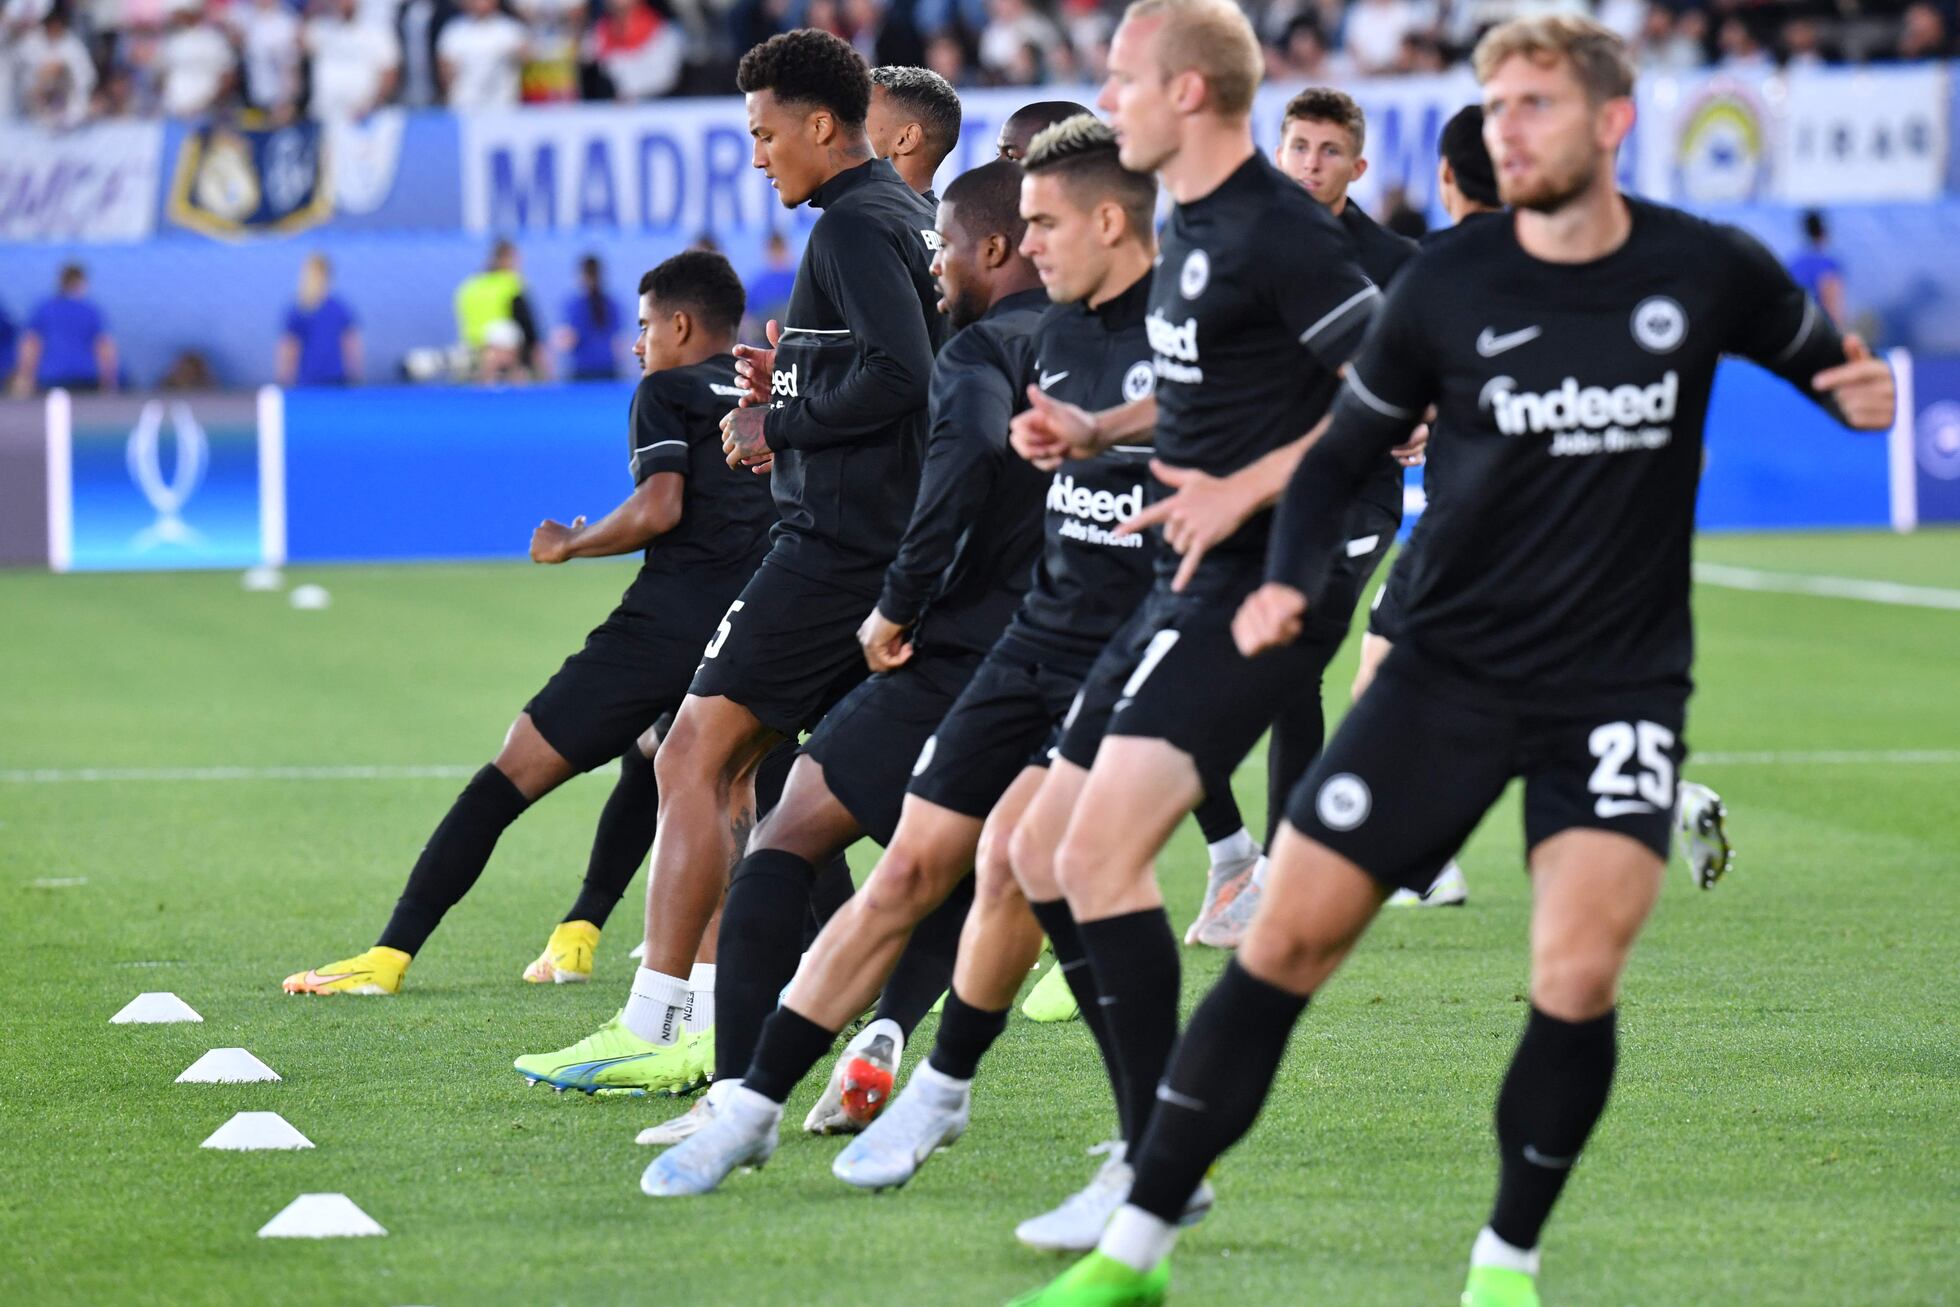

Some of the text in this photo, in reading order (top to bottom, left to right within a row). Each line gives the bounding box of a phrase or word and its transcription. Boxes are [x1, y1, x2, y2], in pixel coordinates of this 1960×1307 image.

[487, 126, 822, 238] MADRI
[1478, 370, 1679, 435] indeed
[1587, 719, 1675, 810] 25
